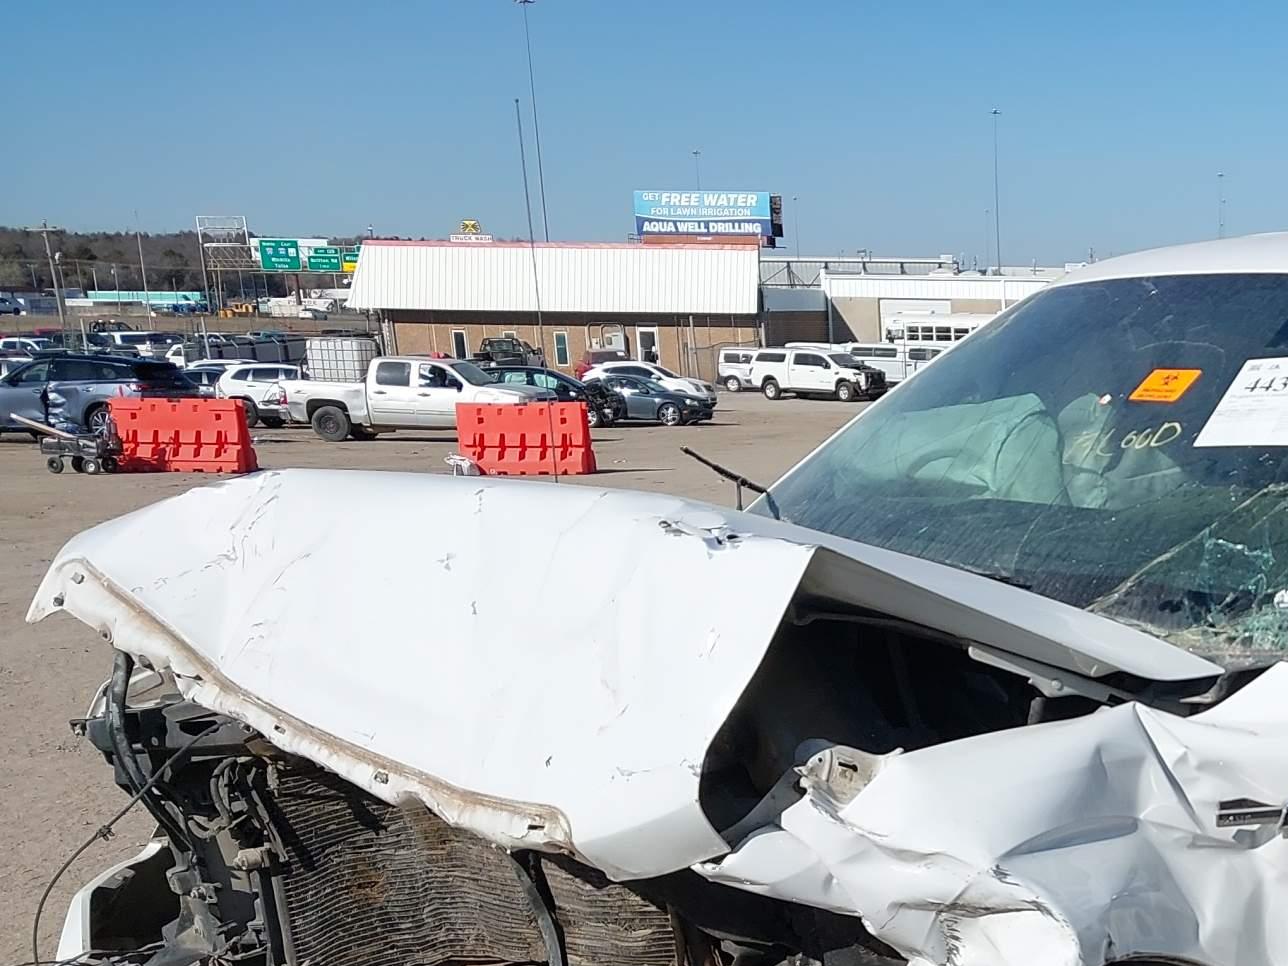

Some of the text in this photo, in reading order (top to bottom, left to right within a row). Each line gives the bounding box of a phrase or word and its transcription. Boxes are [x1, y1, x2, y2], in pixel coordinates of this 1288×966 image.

[642, 192, 758, 207] GET FREE WATER
[650, 208, 751, 217] FOR LAWN IRRIGATION
[642, 221, 762, 234] AQUA WELL DRILLING
